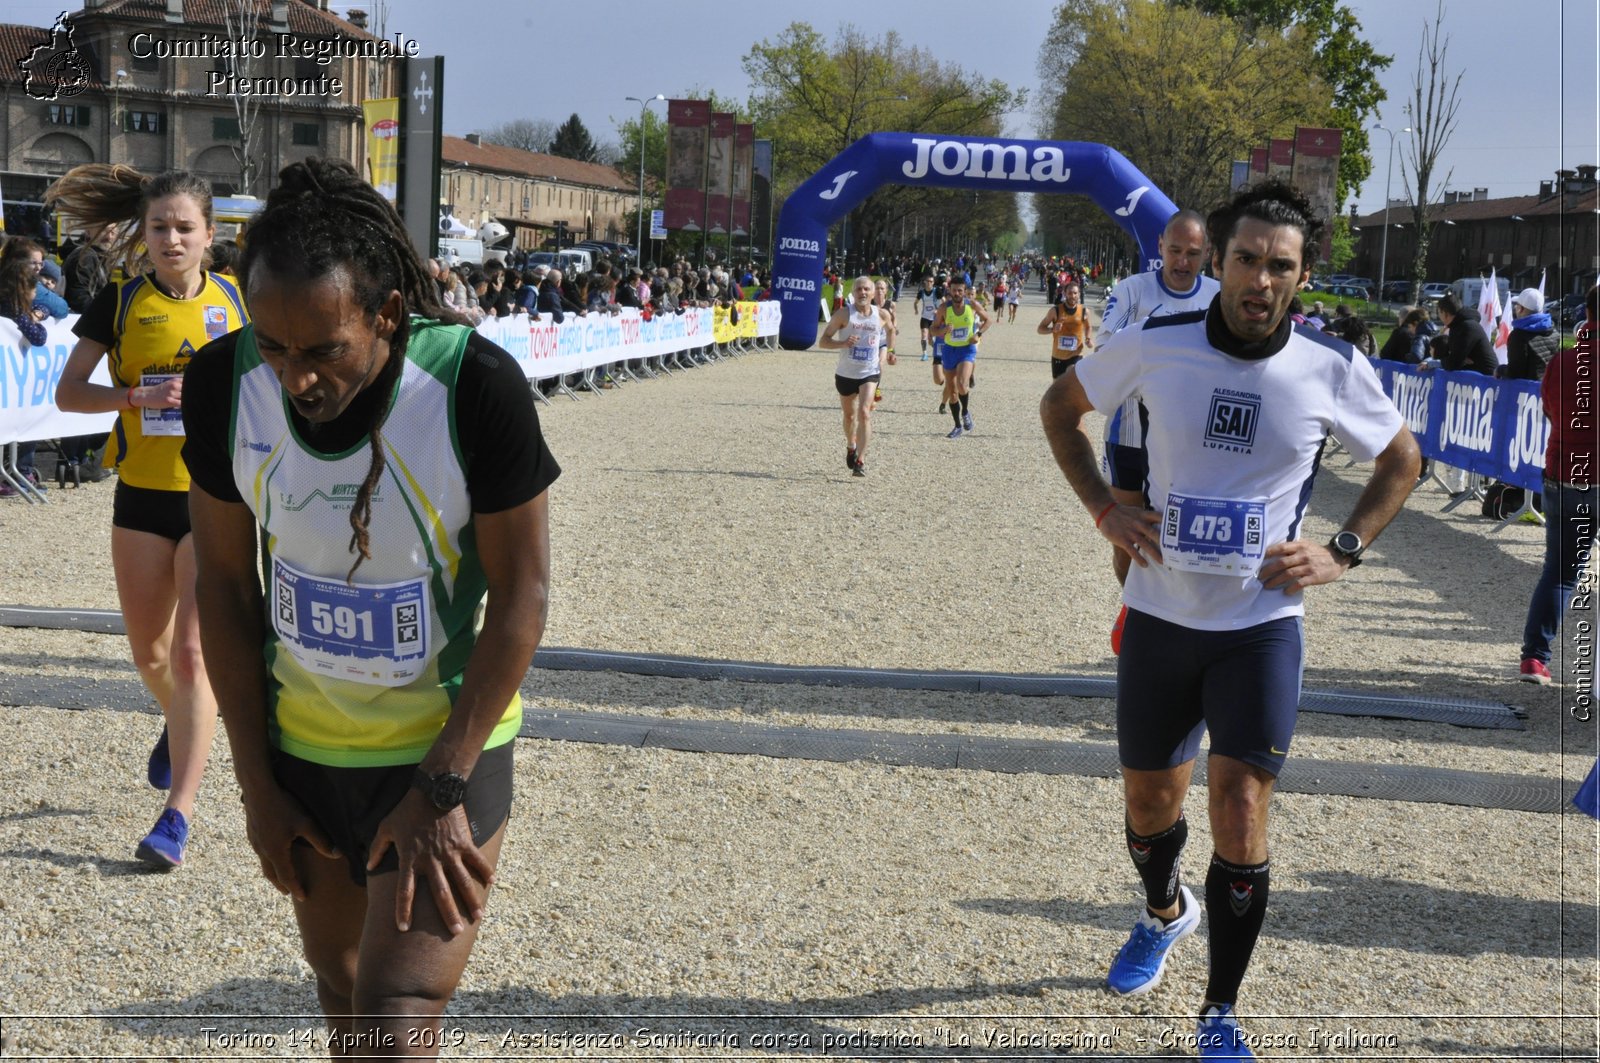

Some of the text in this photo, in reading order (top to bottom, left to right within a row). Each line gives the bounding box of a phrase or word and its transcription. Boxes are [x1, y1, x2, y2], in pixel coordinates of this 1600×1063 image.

[902, 138, 1071, 183] Joma
[779, 237, 820, 253] Joma
[1147, 258, 1164, 272] Jo
[775, 276, 816, 292] Joma
[0, 344, 76, 409] YBR
[1213, 387, 1262, 401] ALESSANDRIA
[1213, 404, 1252, 438] SAI
[1440, 381, 1496, 453] Joma
[1509, 391, 1552, 473] Jom
[1203, 441, 1252, 454] LUPARIA
[1189, 514, 1232, 542] 473
[310, 600, 374, 642] 591
